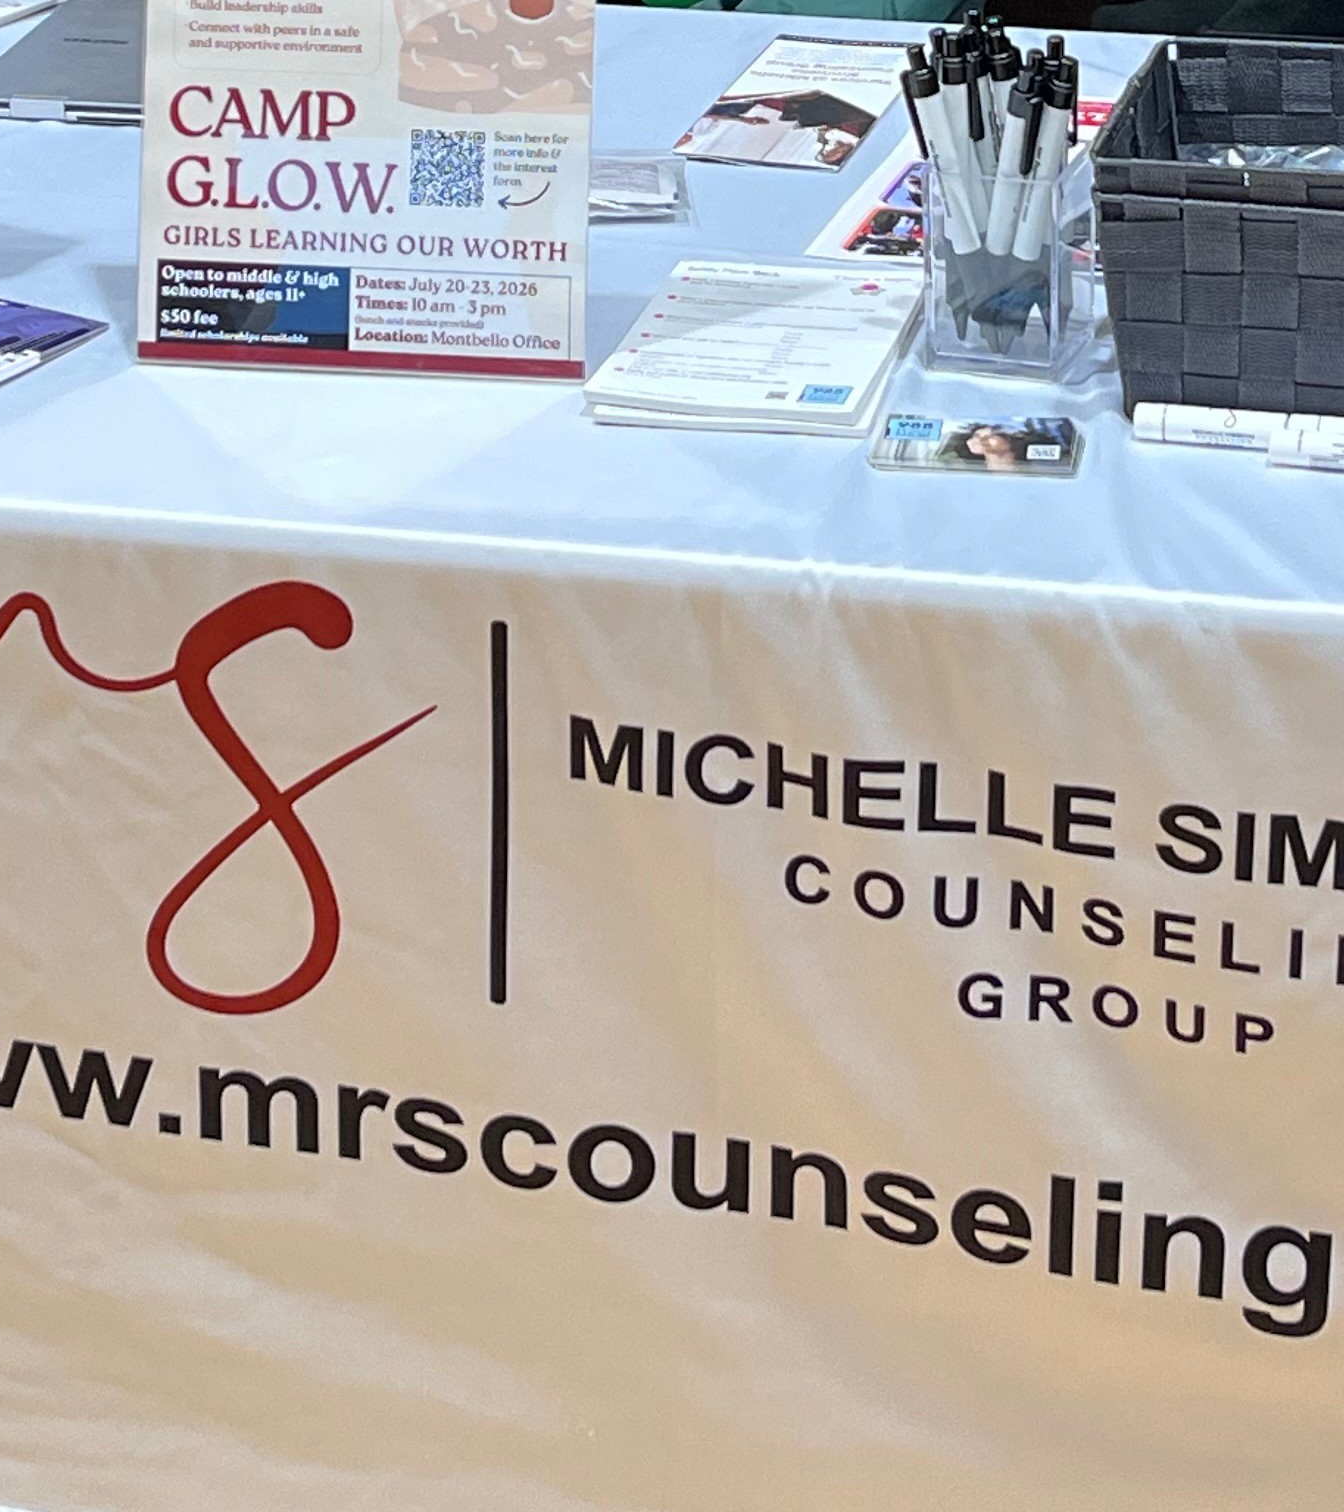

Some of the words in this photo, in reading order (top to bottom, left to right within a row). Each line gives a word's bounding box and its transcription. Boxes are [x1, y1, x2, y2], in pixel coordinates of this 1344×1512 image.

[191, 0, 222, 11] Build
[224, 0, 288, 16] leadership
[291, 2, 323, 14] skills
[189, 21, 240, 33] Connect
[244, 23, 270, 34] with
[273, 24, 307, 37] peers
[310, 25, 321, 36] in
[323, 28, 331, 36] a
[334, 26, 360, 37] safe
[189, 38, 212, 48] and
[215, 39, 280, 52] supportive
[283, 41, 362, 53] environment
[169, 86, 356, 142] CAMP
[493, 131, 520, 143] Scan
[524, 132, 550, 144] here
[552, 133, 569, 145] for
[493, 148, 524, 158] more
[527, 147, 548, 159] info
[493, 161, 511, 172] the
[514, 162, 557, 173] interest
[167, 155, 398, 214] G.L.O.W.
[493, 175, 522, 187] form
[164, 225, 241, 248] GIRLS
[251, 228, 387, 254] LEARNING
[397, 235, 454, 257] OUR
[464, 238, 567, 262] WORTH
[162, 265, 204, 284] Open
[208, 268, 224, 282] to
[228, 267, 282, 284] middle
[285, 268, 301, 284] &
[303, 268, 339, 288] high
[355, 274, 405, 291] Dates:
[409, 277, 440, 294] July
[445, 279, 495, 297] 20-23,
[498, 281, 537, 297] 2026
[161, 283, 243, 301] schoolers,
[246, 288, 282, 303] ages
[286, 287, 306, 301] 11+
[356, 295, 408, 311] Times:
[411, 298, 427, 312] 10
[430, 301, 455, 313] am
[467, 299, 477, 313] 3
[481, 303, 506, 317] pm
[161, 309, 190, 326] $50
[193, 309, 218, 325] fee
[355, 327, 428, 345] Location:
[431, 331, 509, 348] Montbello
[513, 334, 560, 351] Office
[568, 714, 1118, 860] MICHELLE
[957, 972, 1280, 1059] GROUP
